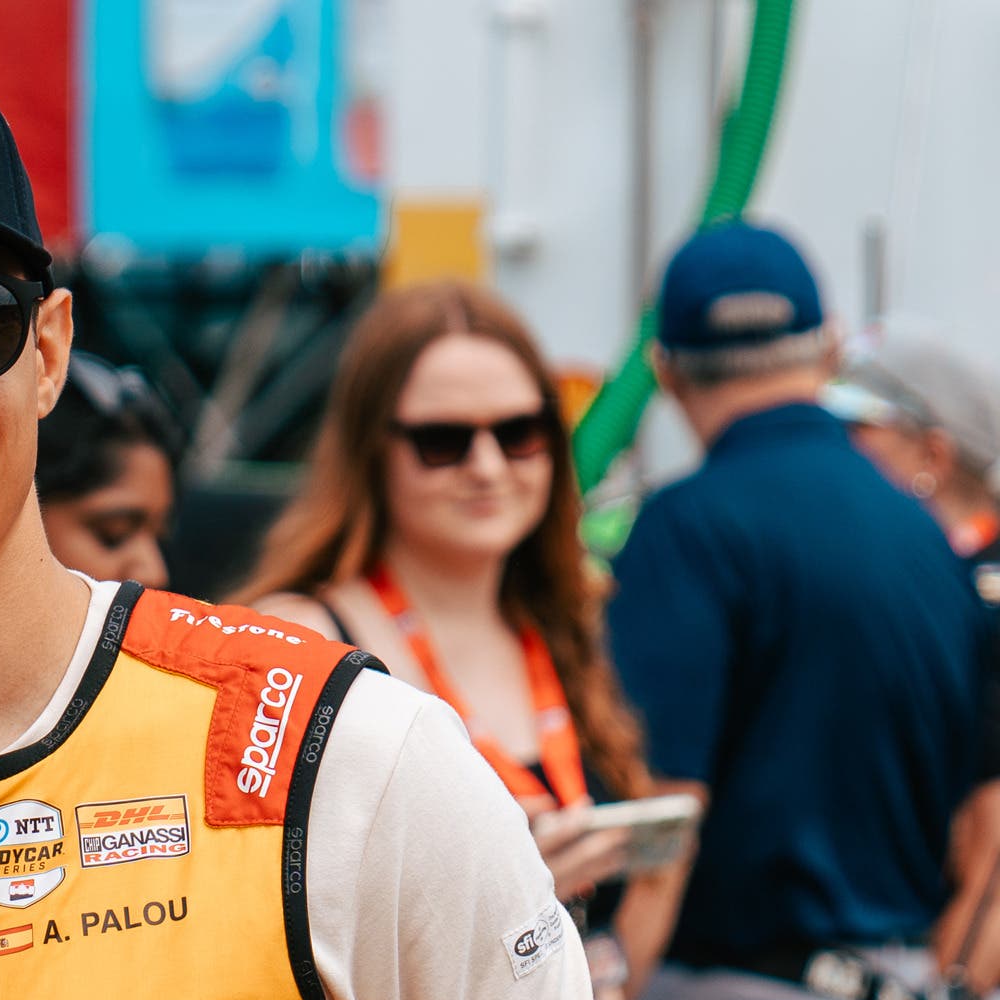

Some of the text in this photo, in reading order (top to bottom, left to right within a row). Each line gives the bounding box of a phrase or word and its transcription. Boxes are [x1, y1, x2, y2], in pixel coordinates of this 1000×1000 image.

[169, 608, 303, 645] Firestone
[237, 668, 302, 797] sparco
[15, 816, 54, 835] NTT
[94, 805, 169, 828] DHL
[84, 827, 186, 853] CHIP GANASSI
[84, 843, 187, 863] RACING
[43, 897, 188, 945] A. PALOU
